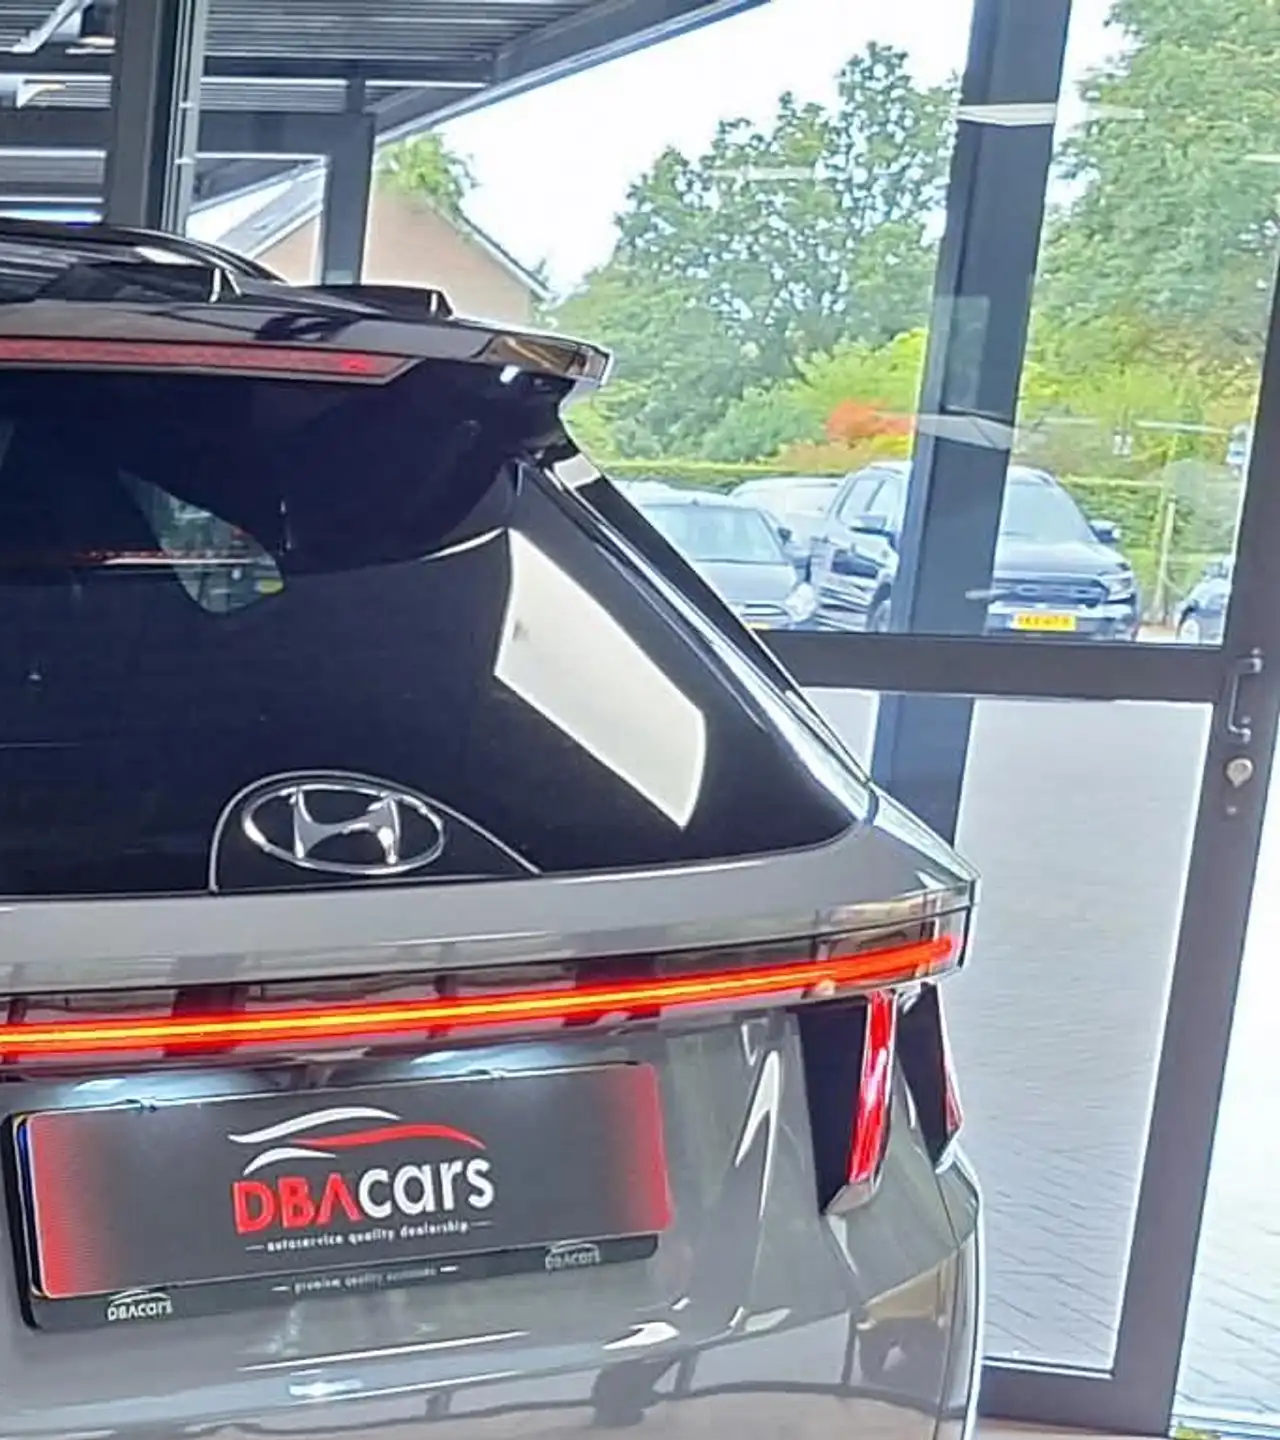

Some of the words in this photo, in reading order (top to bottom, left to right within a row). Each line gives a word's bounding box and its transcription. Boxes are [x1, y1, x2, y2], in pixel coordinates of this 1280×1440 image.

[232, 1157, 495, 1236] DBAcars
[347, 1225, 395, 1246] quality
[399, 1218, 469, 1241] dealership
